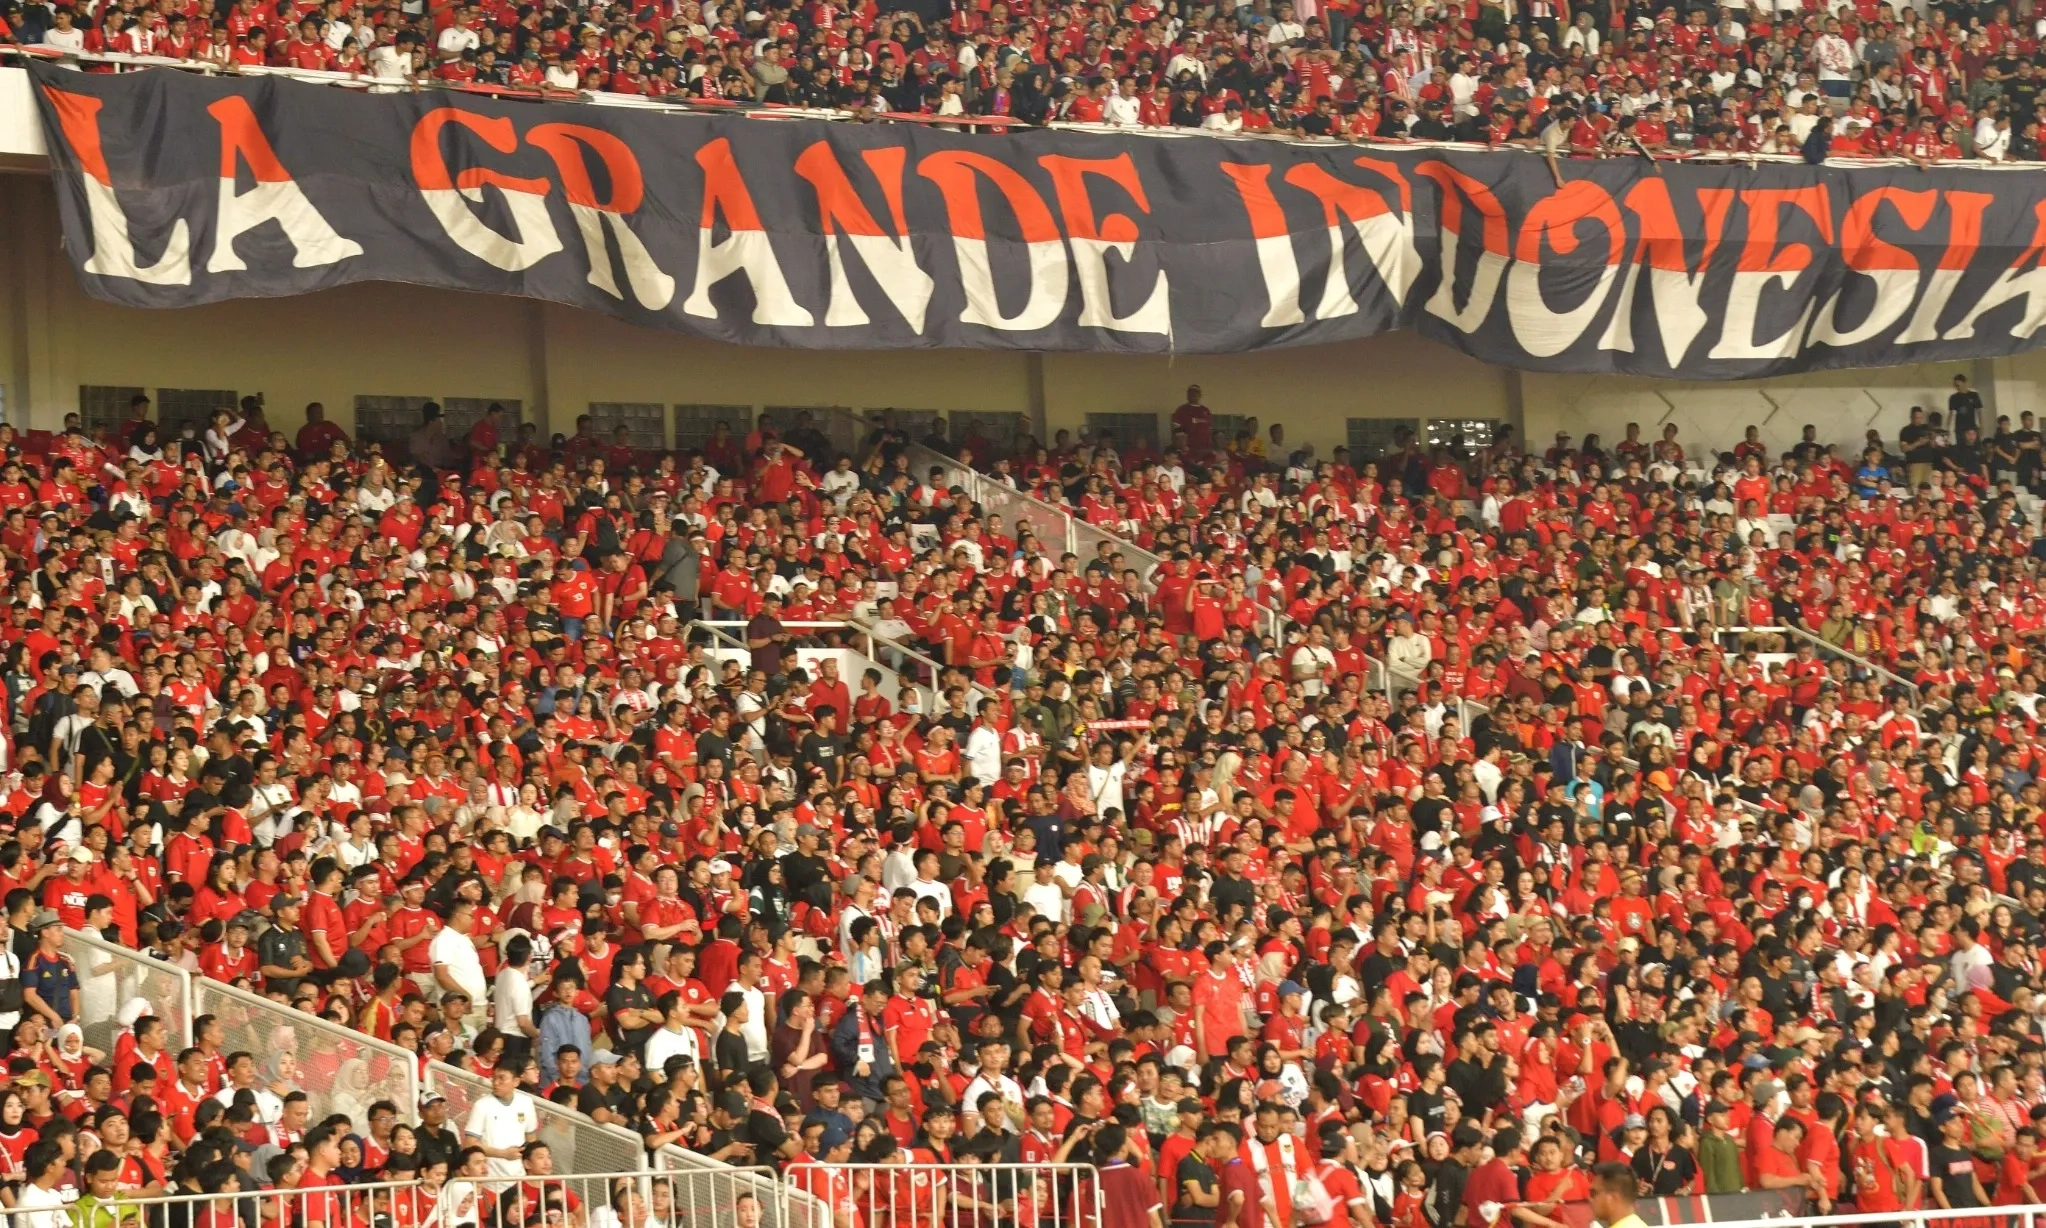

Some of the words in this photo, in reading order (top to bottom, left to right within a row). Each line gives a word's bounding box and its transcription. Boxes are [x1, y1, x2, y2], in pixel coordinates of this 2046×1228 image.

[42, 85, 364, 286] LA
[410, 107, 1170, 335] GRANDE
[1219, 156, 2046, 368] INDONESIA
